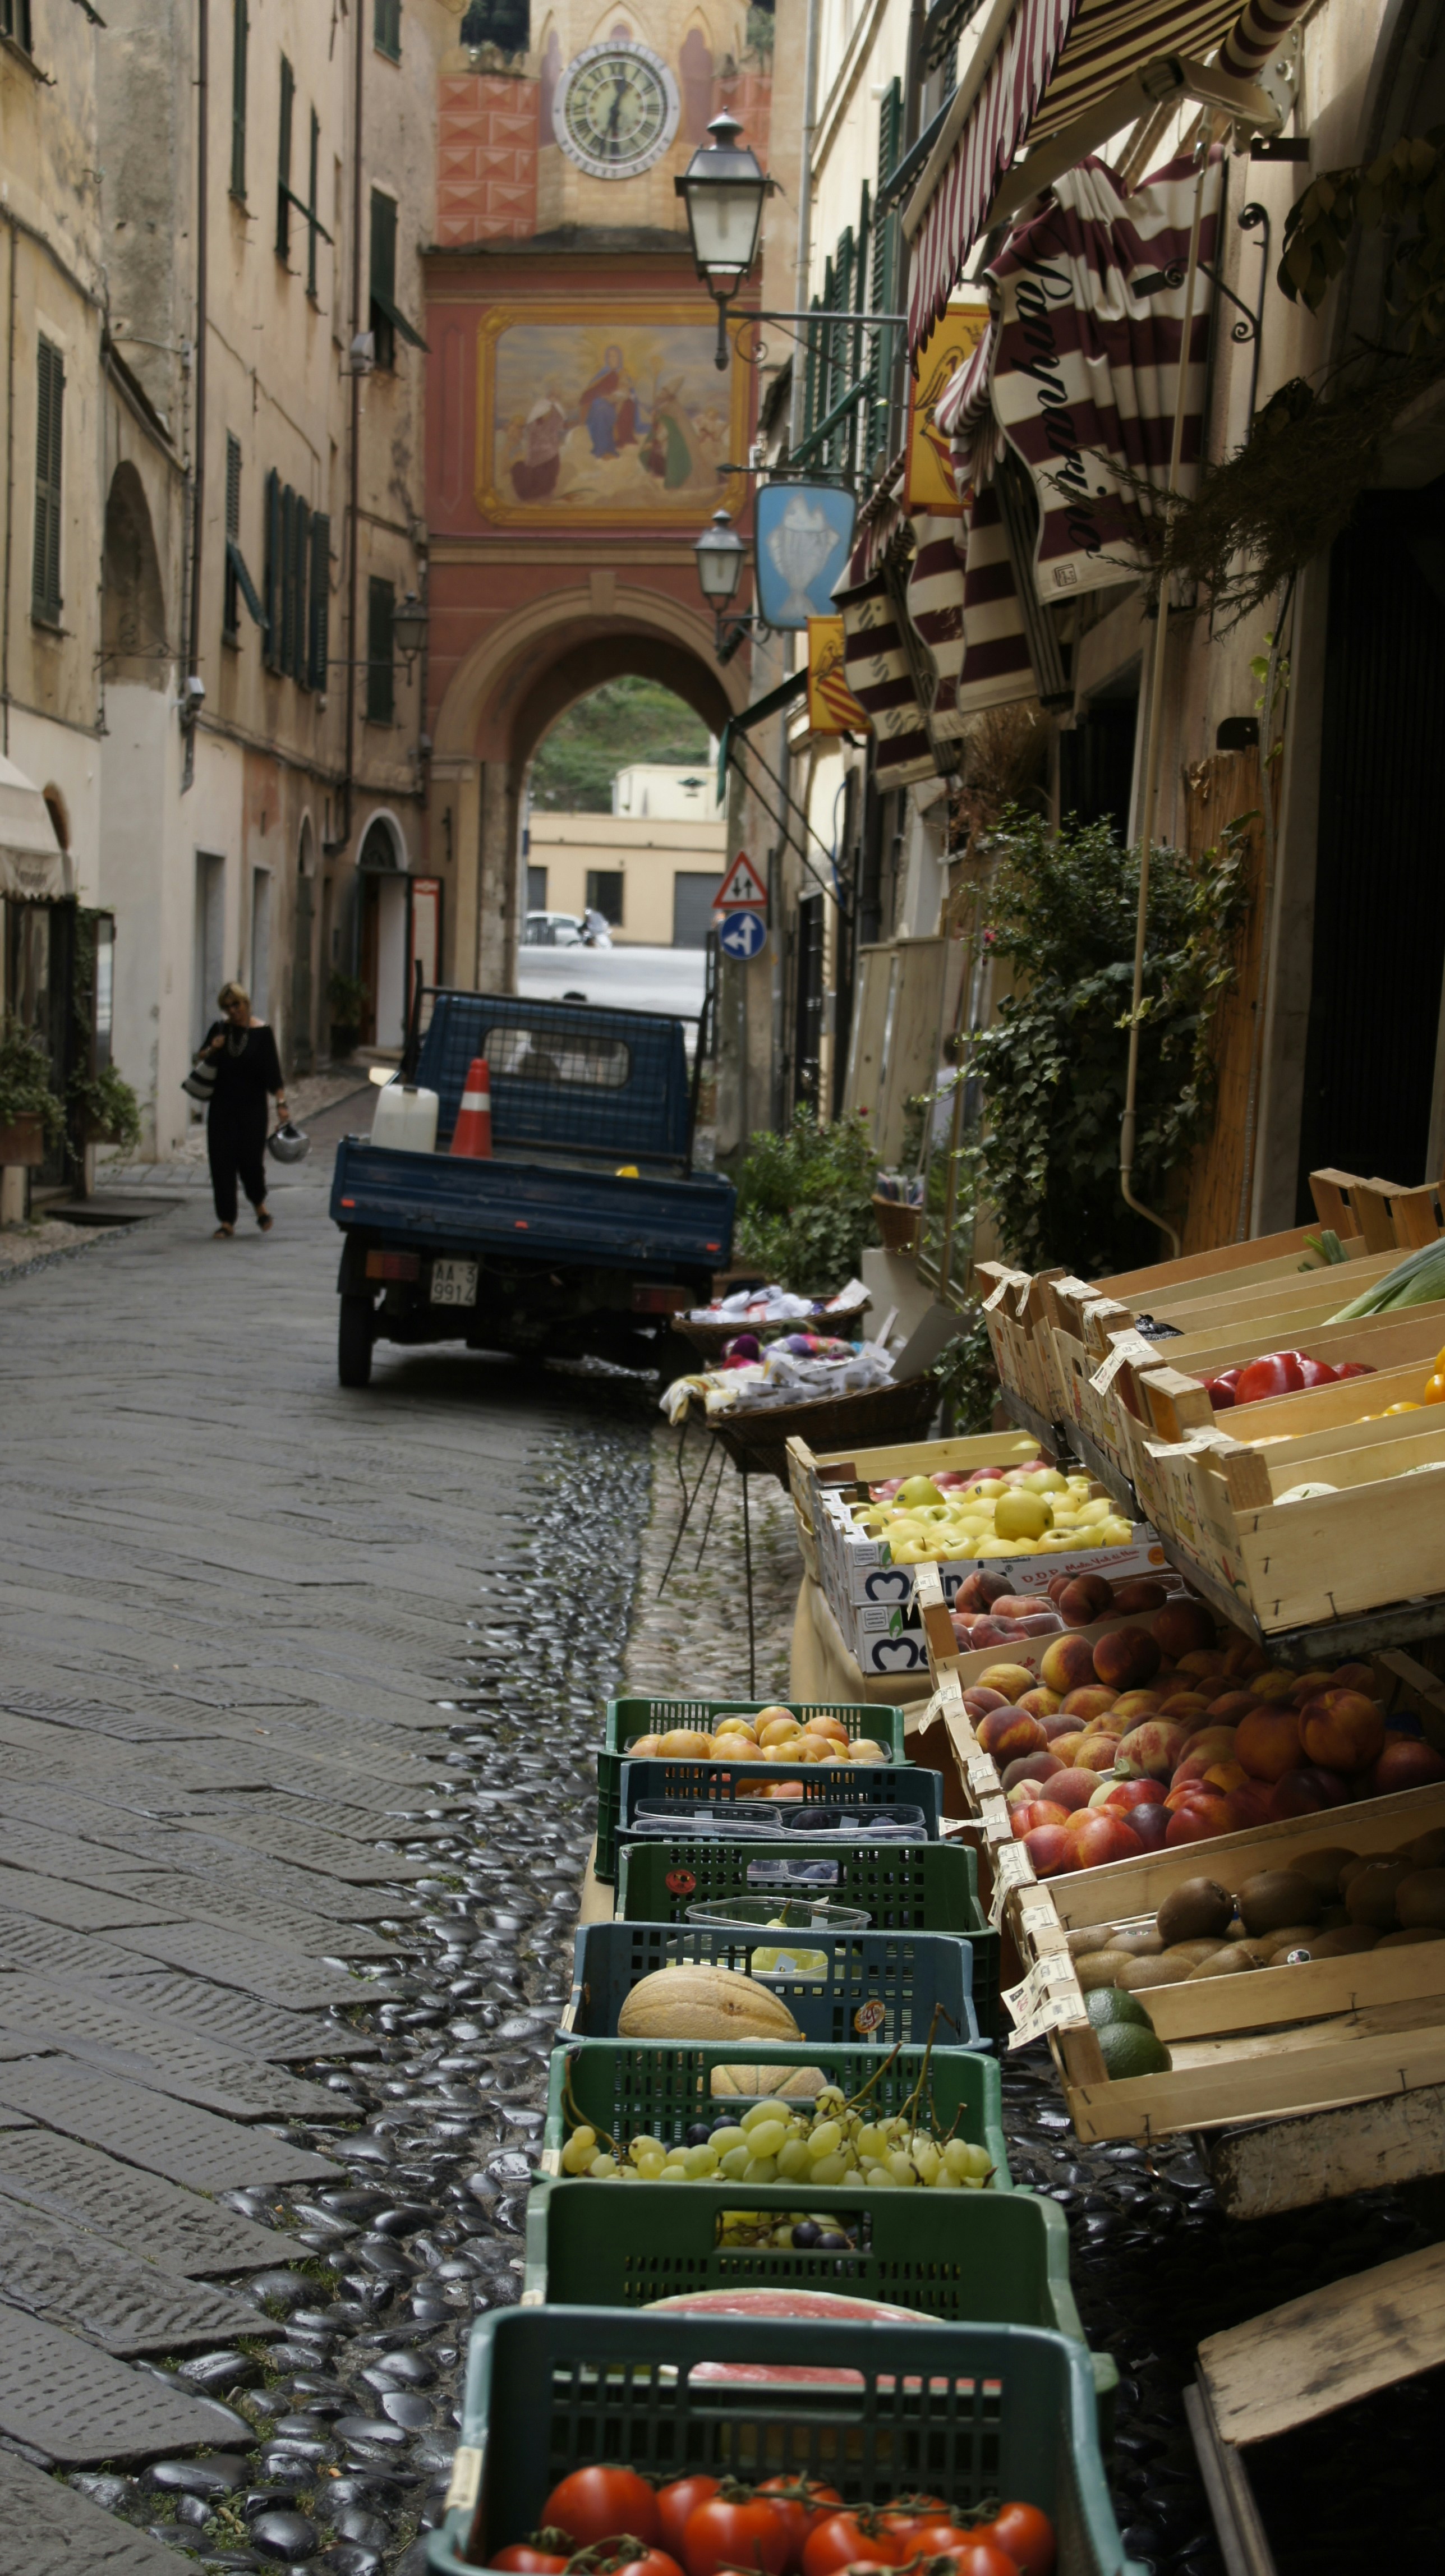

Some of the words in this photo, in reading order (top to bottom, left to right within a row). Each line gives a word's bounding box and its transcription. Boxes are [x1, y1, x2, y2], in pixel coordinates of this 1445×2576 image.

[1009, 223, 1107, 559] Pamparino
[435, 1264, 454, 1282] AA
[466, 1264, 476, 1284] 3
